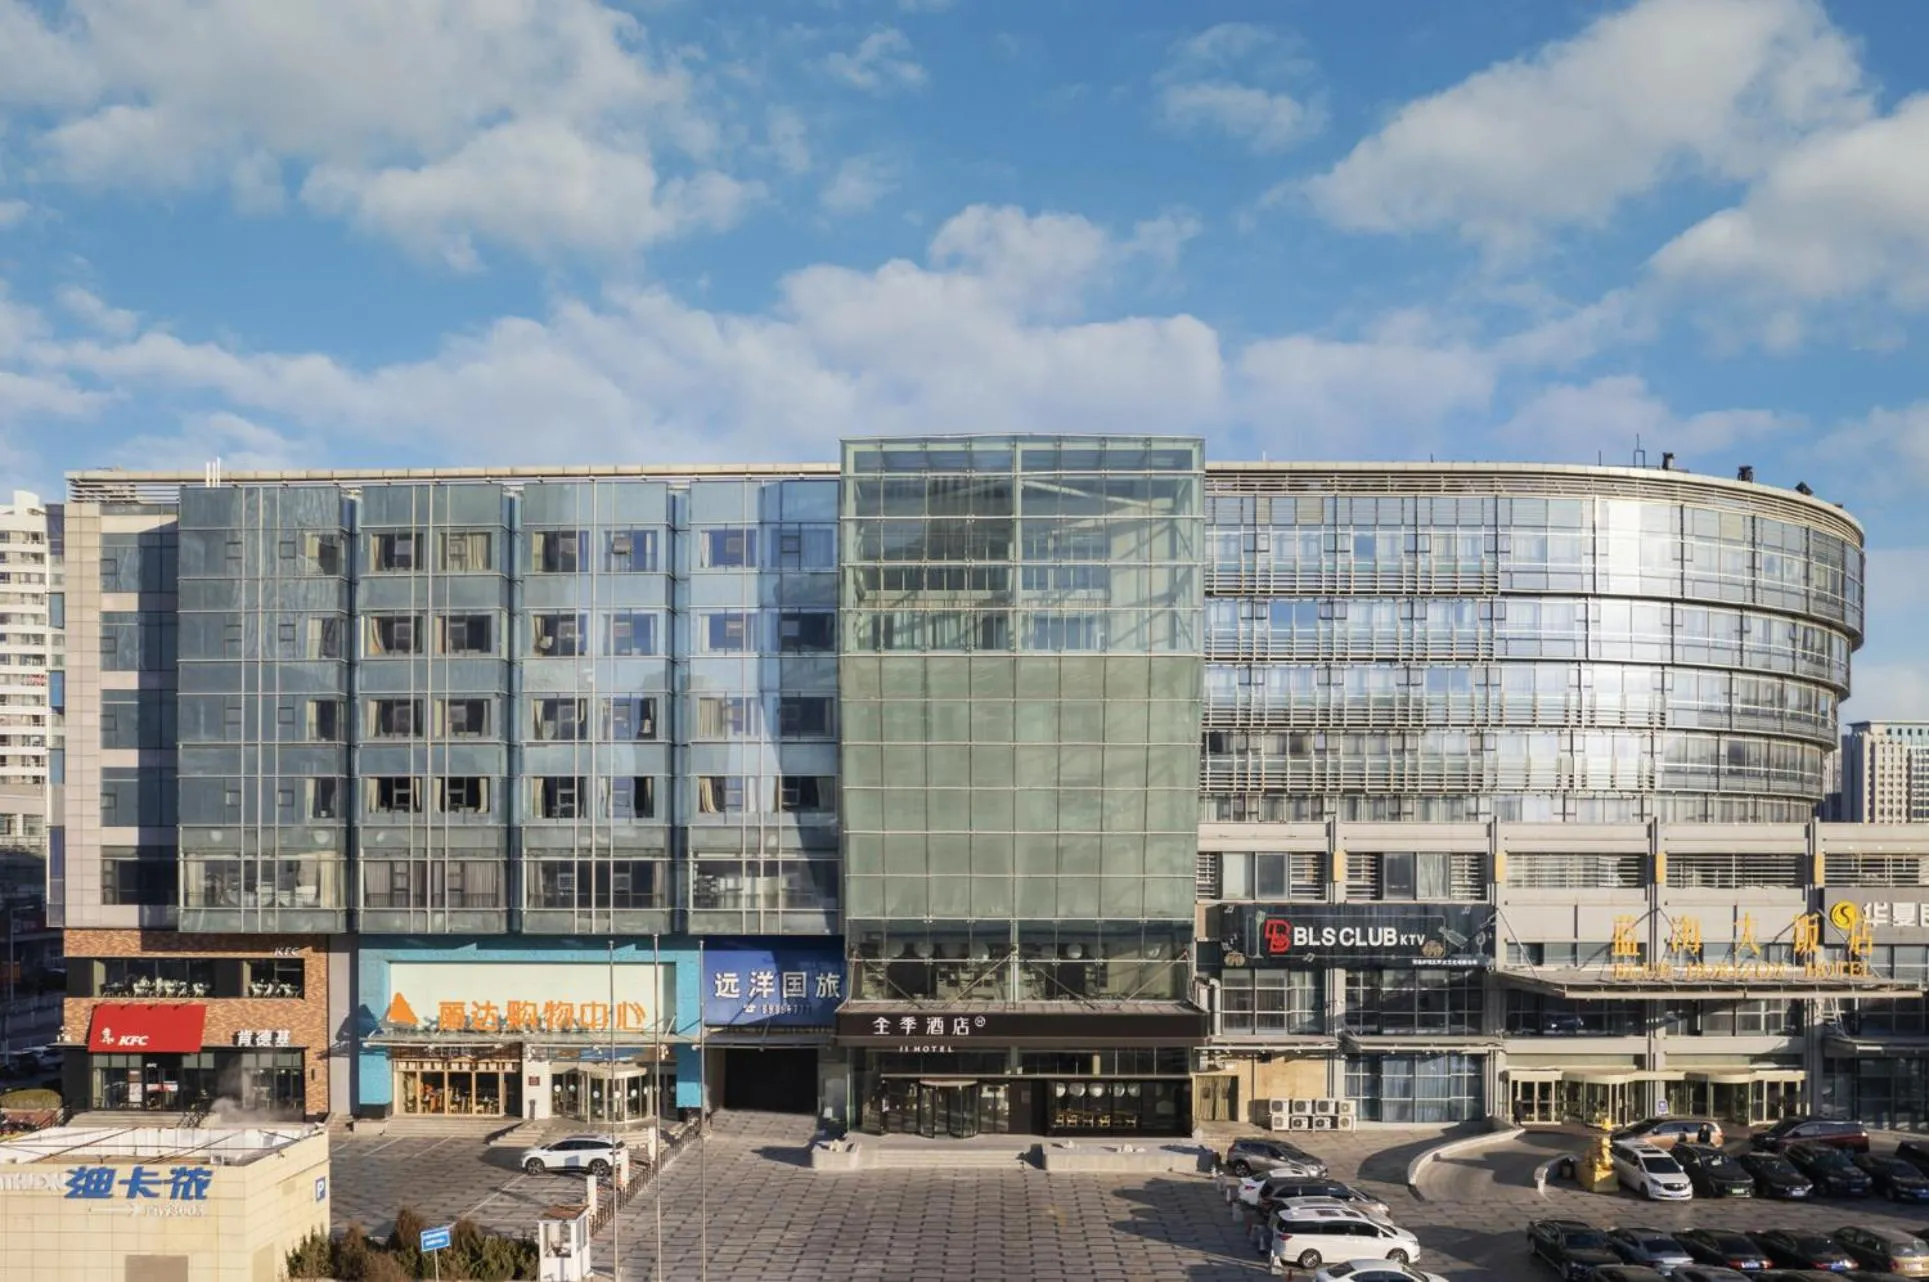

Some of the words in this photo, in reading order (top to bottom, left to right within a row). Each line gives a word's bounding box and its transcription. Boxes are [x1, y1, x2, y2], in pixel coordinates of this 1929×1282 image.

[1339, 927, 1398, 946] CLUB
[1400, 934, 1426, 946] KTV
[1805, 960, 1871, 977] HOTEL
[715, 971, 841, 998] 远洋国旅
[872, 1016, 970, 1036] 全季酒店
[118, 1035, 149, 1046] KFC
[237, 1029, 291, 1047] 肯德基
[914, 1045, 955, 1053] HOTEL
[64, 1165, 213, 1200] 迪卡侬
